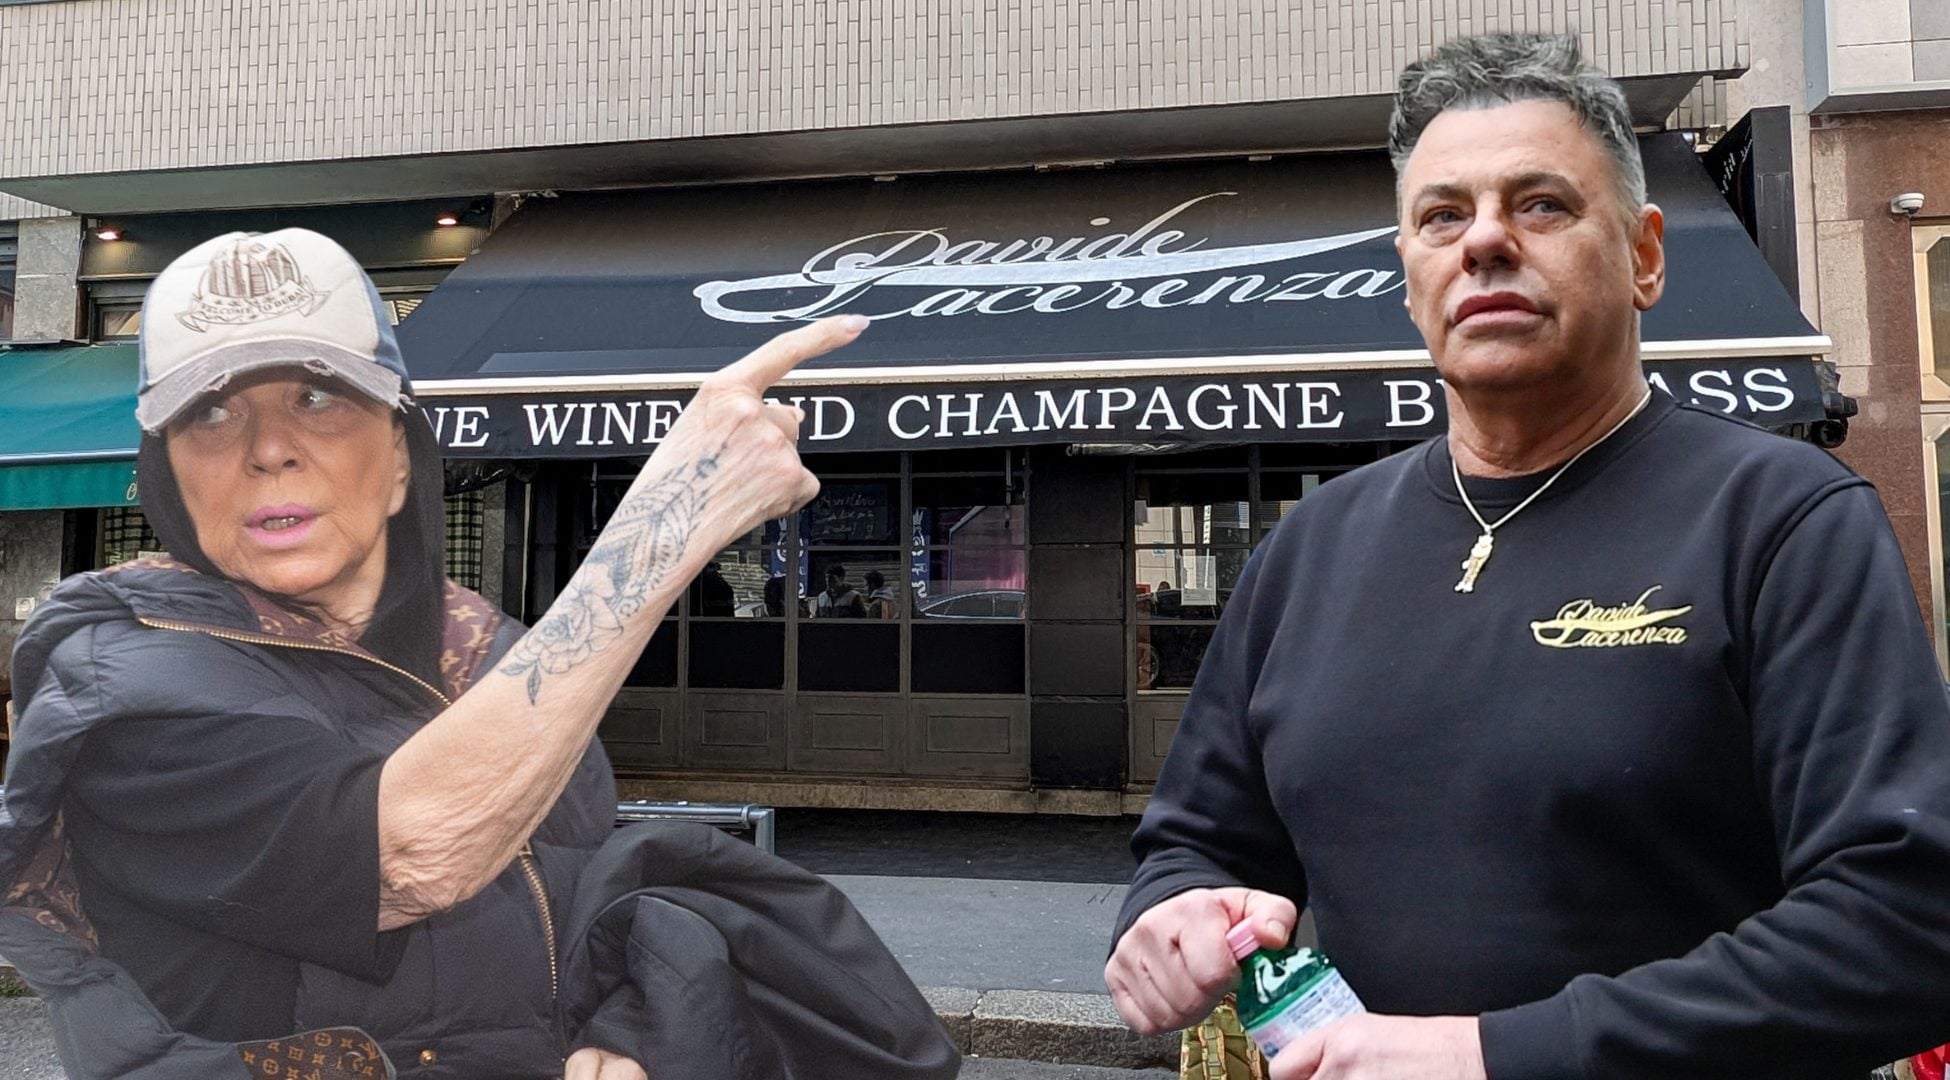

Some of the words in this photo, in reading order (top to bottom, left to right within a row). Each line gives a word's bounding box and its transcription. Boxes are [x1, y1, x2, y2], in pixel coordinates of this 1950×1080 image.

[802, 192, 1238, 276] Davide
[693, 262, 1406, 322] Lacerenza
[522, 400, 683, 446] WINE
[888, 382, 1344, 440] CHAMPAGNE
[1556, 585, 1662, 622] Davide
[1531, 621, 1688, 648] Lacerenza
